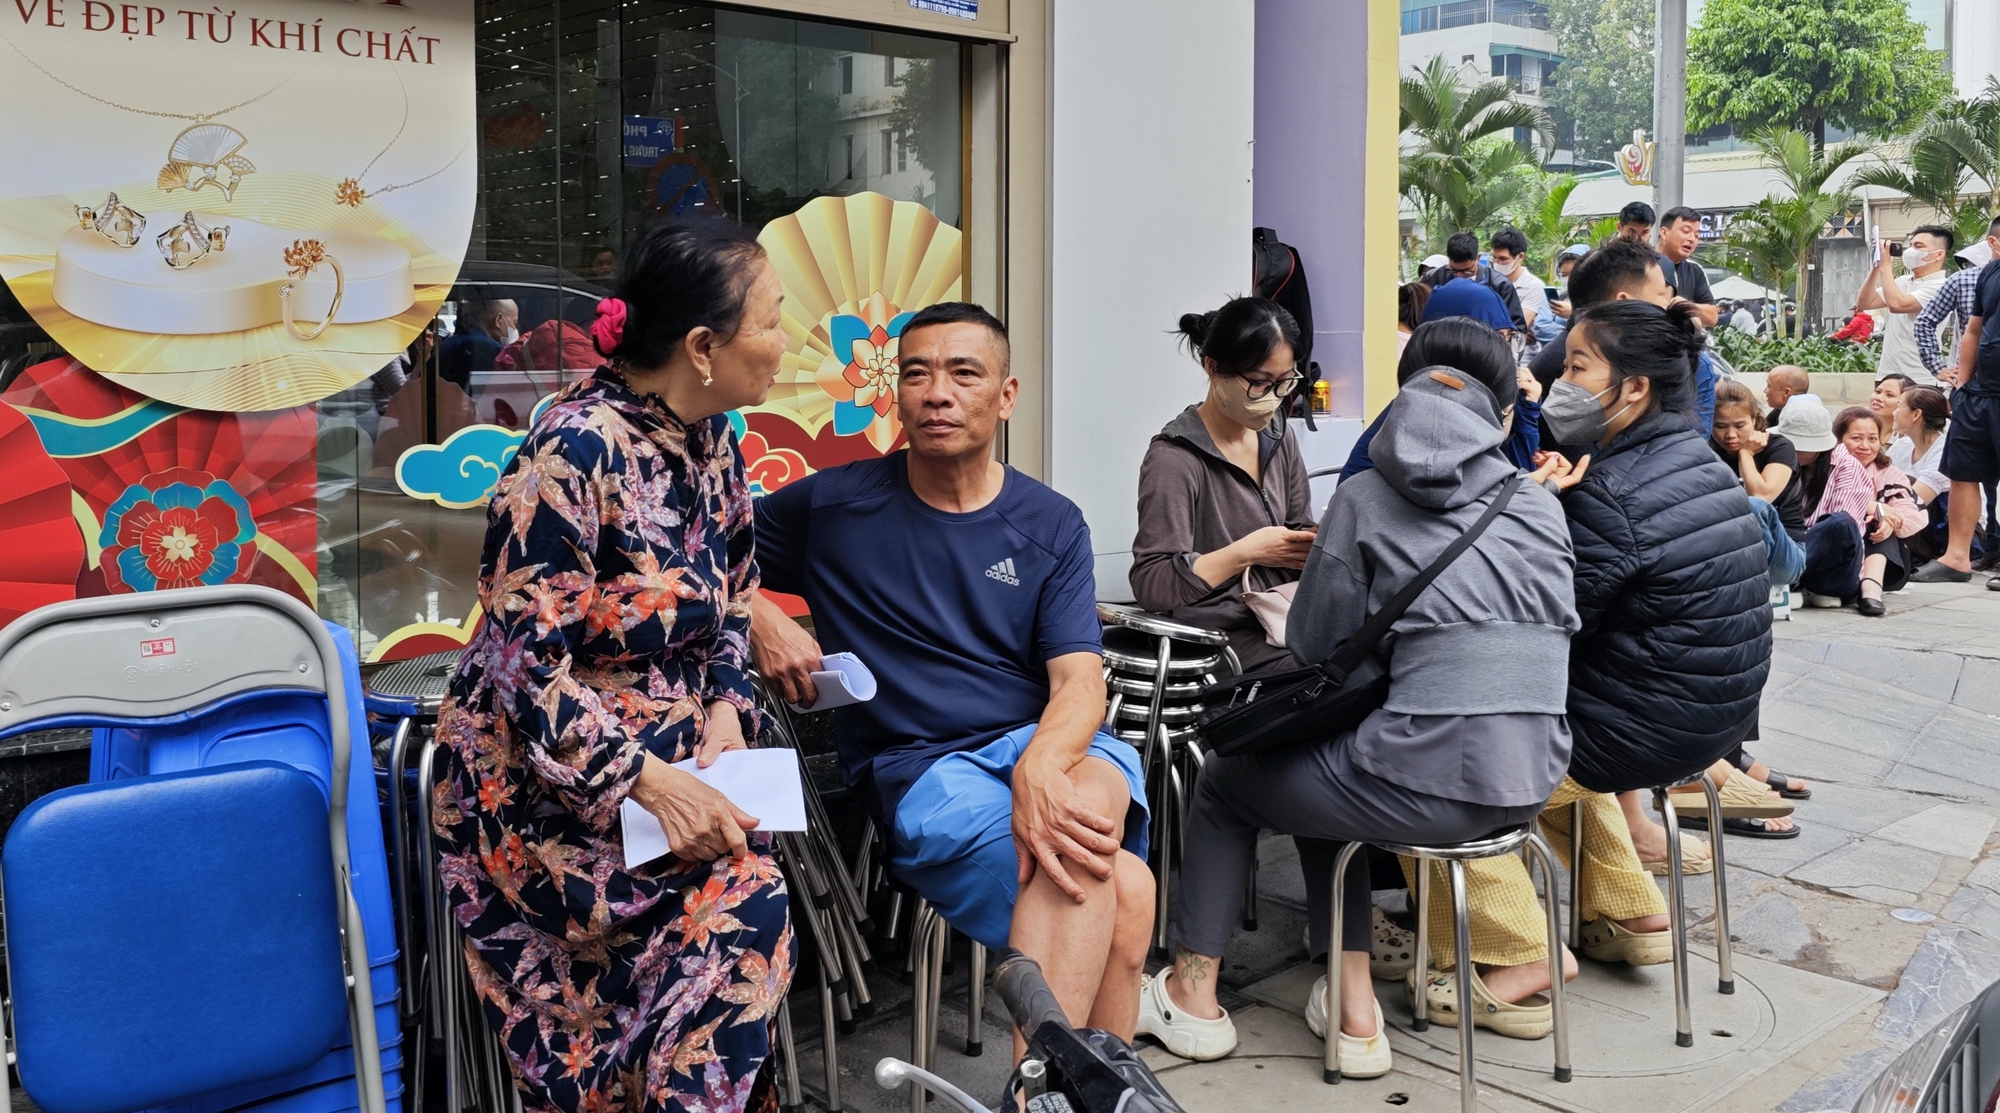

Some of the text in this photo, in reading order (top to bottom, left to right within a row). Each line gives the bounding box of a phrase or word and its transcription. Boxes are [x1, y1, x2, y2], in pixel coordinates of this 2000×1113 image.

[81, 1, 165, 41] ĐẸP
[177, 6, 236, 43] TỪ
[249, 17, 323, 53] KHÍ
[336, 25, 440, 65] CHẤT
[985, 569, 1020, 586] adidas
